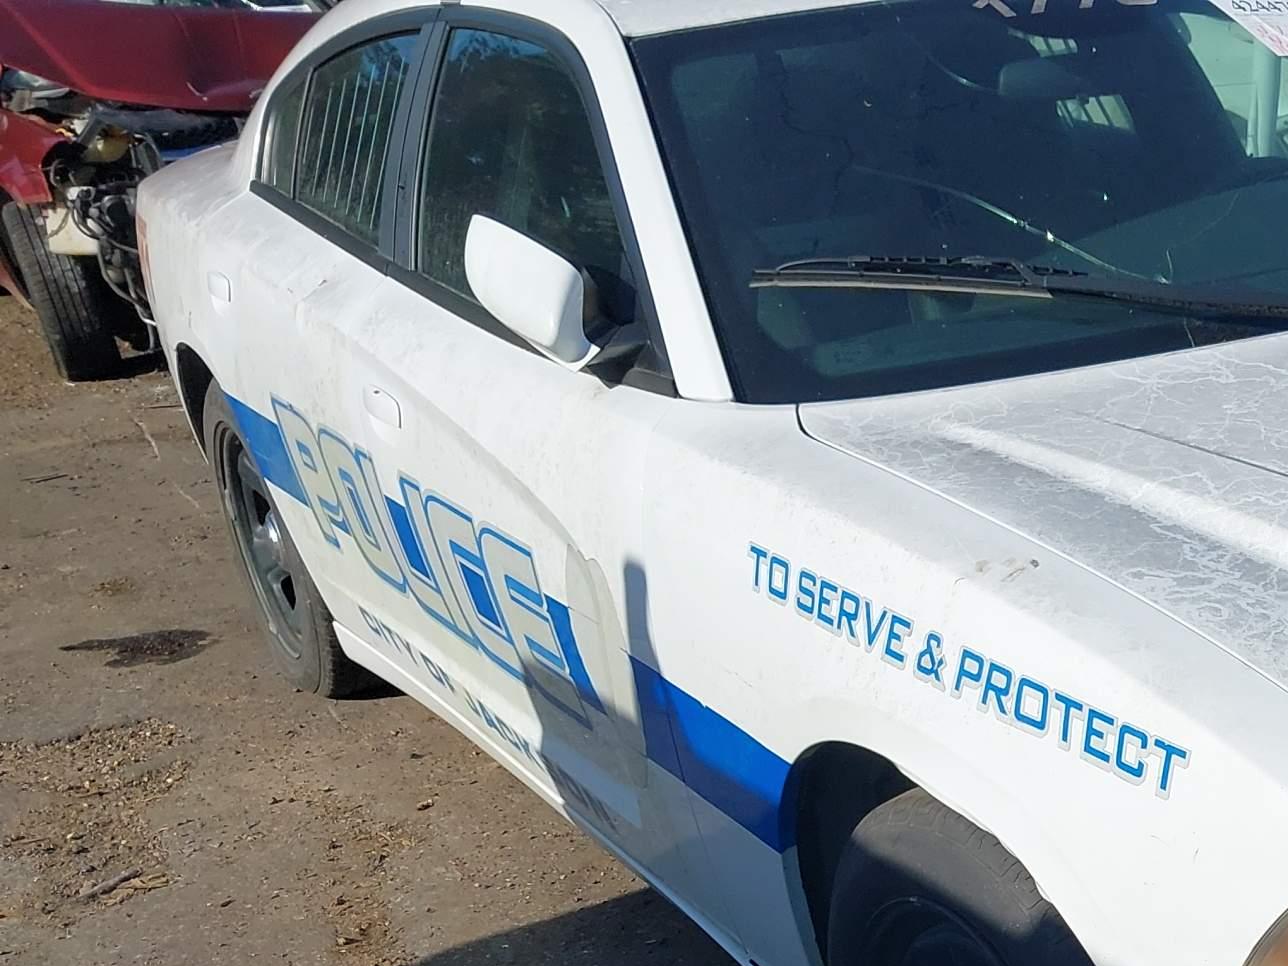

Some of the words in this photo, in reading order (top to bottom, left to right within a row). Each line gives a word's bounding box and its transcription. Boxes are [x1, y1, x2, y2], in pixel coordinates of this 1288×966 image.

[270, 392, 594, 731] POLICE
[358, 604, 418, 666] CITY
[419, 651, 455, 693] OF
[748, 542, 791, 604] TO
[797, 568, 914, 669] SERVE
[914, 631, 947, 693] &
[951, 645, 1190, 800] PROTECT
